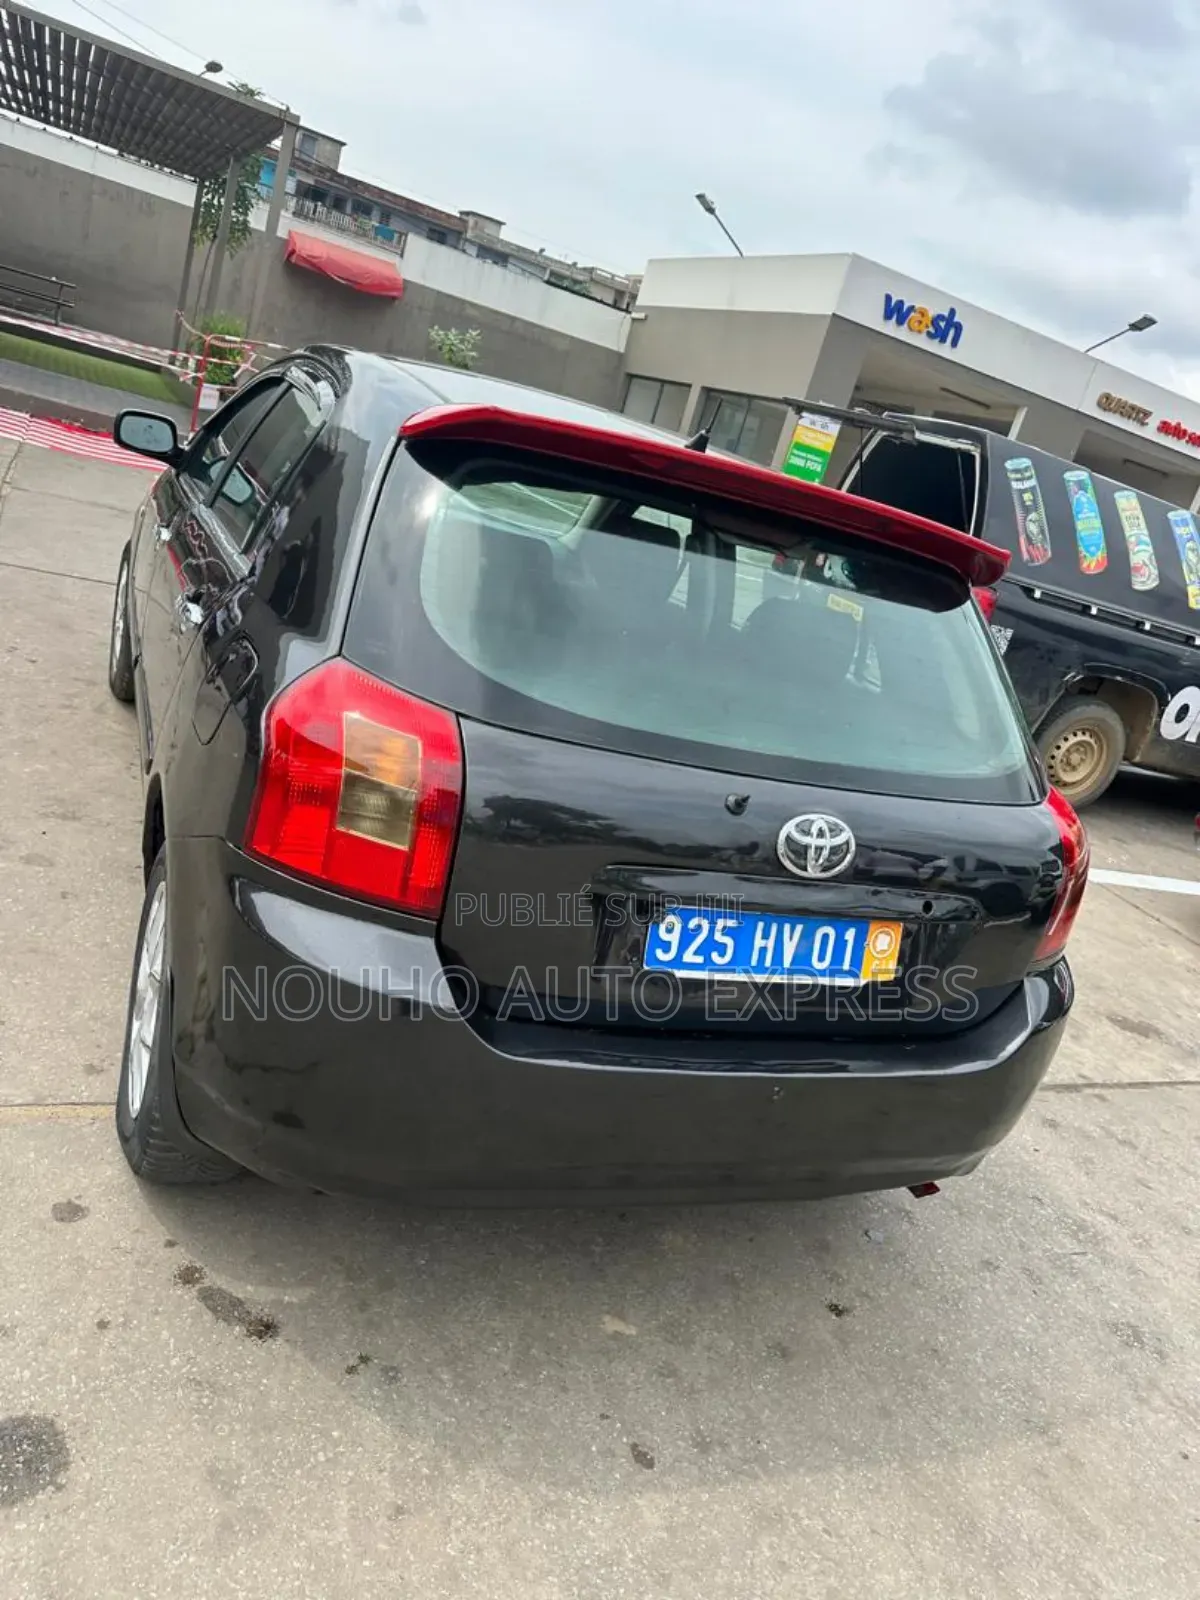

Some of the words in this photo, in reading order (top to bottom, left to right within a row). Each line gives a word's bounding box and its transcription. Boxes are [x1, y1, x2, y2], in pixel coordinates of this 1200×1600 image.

[883, 292, 963, 348] wash
[1096, 391, 1153, 427] QUARTZ
[1156, 420, 1188, 441] auto
[655, 915, 738, 965] 925
[750, 920, 803, 969] HV
[811, 925, 856, 971] 01
